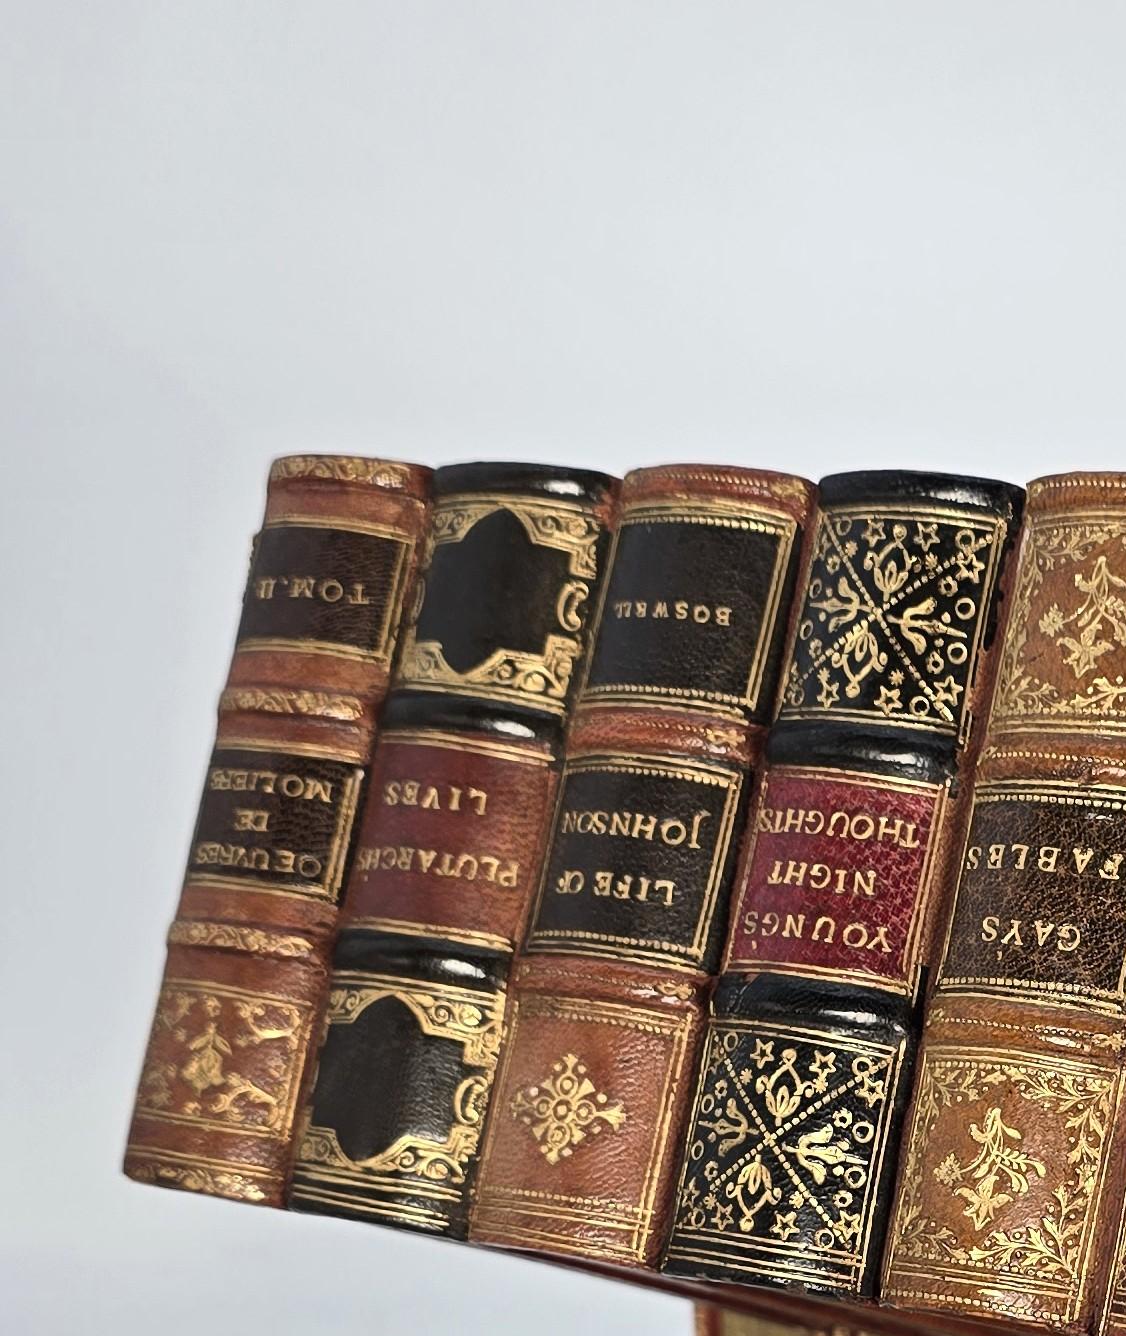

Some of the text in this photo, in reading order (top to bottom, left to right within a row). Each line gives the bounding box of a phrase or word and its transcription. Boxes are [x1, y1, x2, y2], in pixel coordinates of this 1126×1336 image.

[613, 600, 732, 626] BOSWELL
[383, 780, 487, 816] LIVES
[233, 809, 271, 833] DE
[561, 810, 711, 849] JOHNSON
[758, 808, 920, 848] THOUGHTS
[356, 847, 520, 887] PLUTARCH'S
[767, 861, 877, 896] NIGHT
[966, 844, 1124, 880] FABLES
[556, 869, 676, 906] LIFE OF
[743, 911, 892, 952] YOUNG'S
[981, 916, 1081, 960] GAY'S
